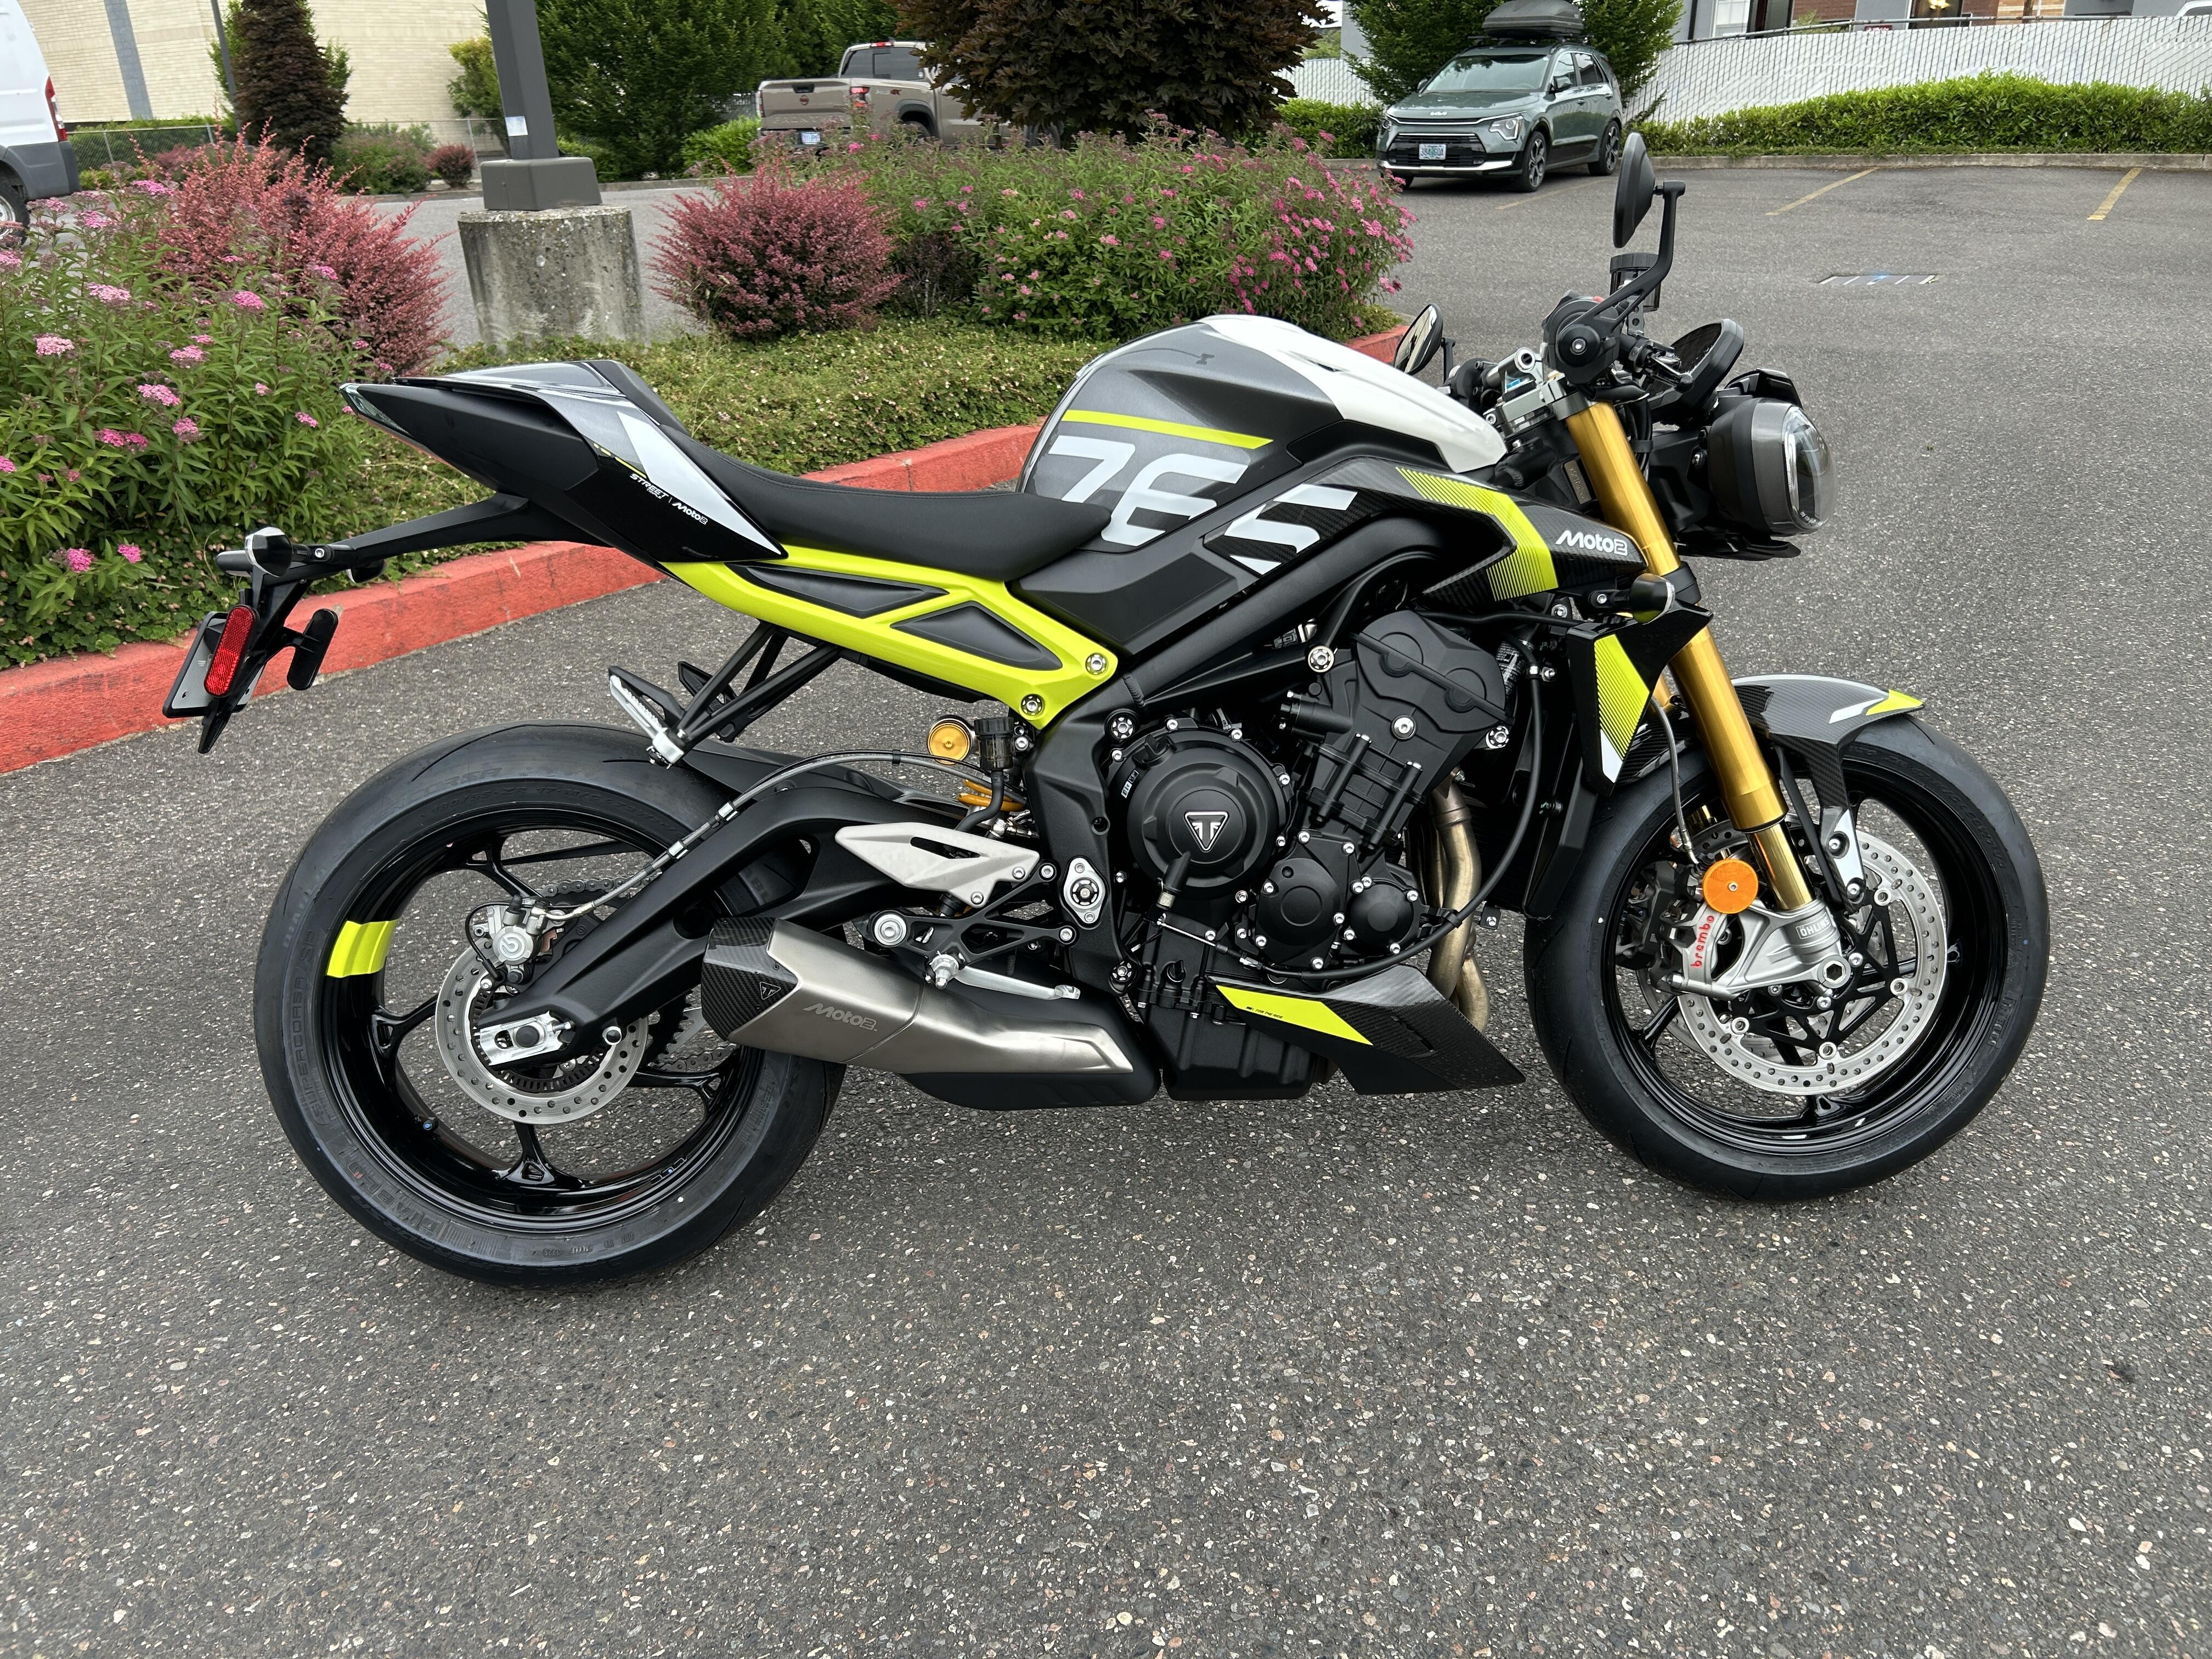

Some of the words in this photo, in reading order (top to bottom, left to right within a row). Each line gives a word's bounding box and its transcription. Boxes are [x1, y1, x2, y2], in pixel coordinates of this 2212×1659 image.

[629, 473, 669, 499] STREET
[673, 502, 708, 525] Moto2
[1555, 530, 1628, 556] Moto2
[1690, 915, 1714, 969] brembo
[1800, 916, 1830, 938] ÖHLINS
[803, 1002, 877, 1031] Moto2
[291, 976, 324, 1118] SUPERCORSA
[346, 1160, 438, 1235] DIABLO
